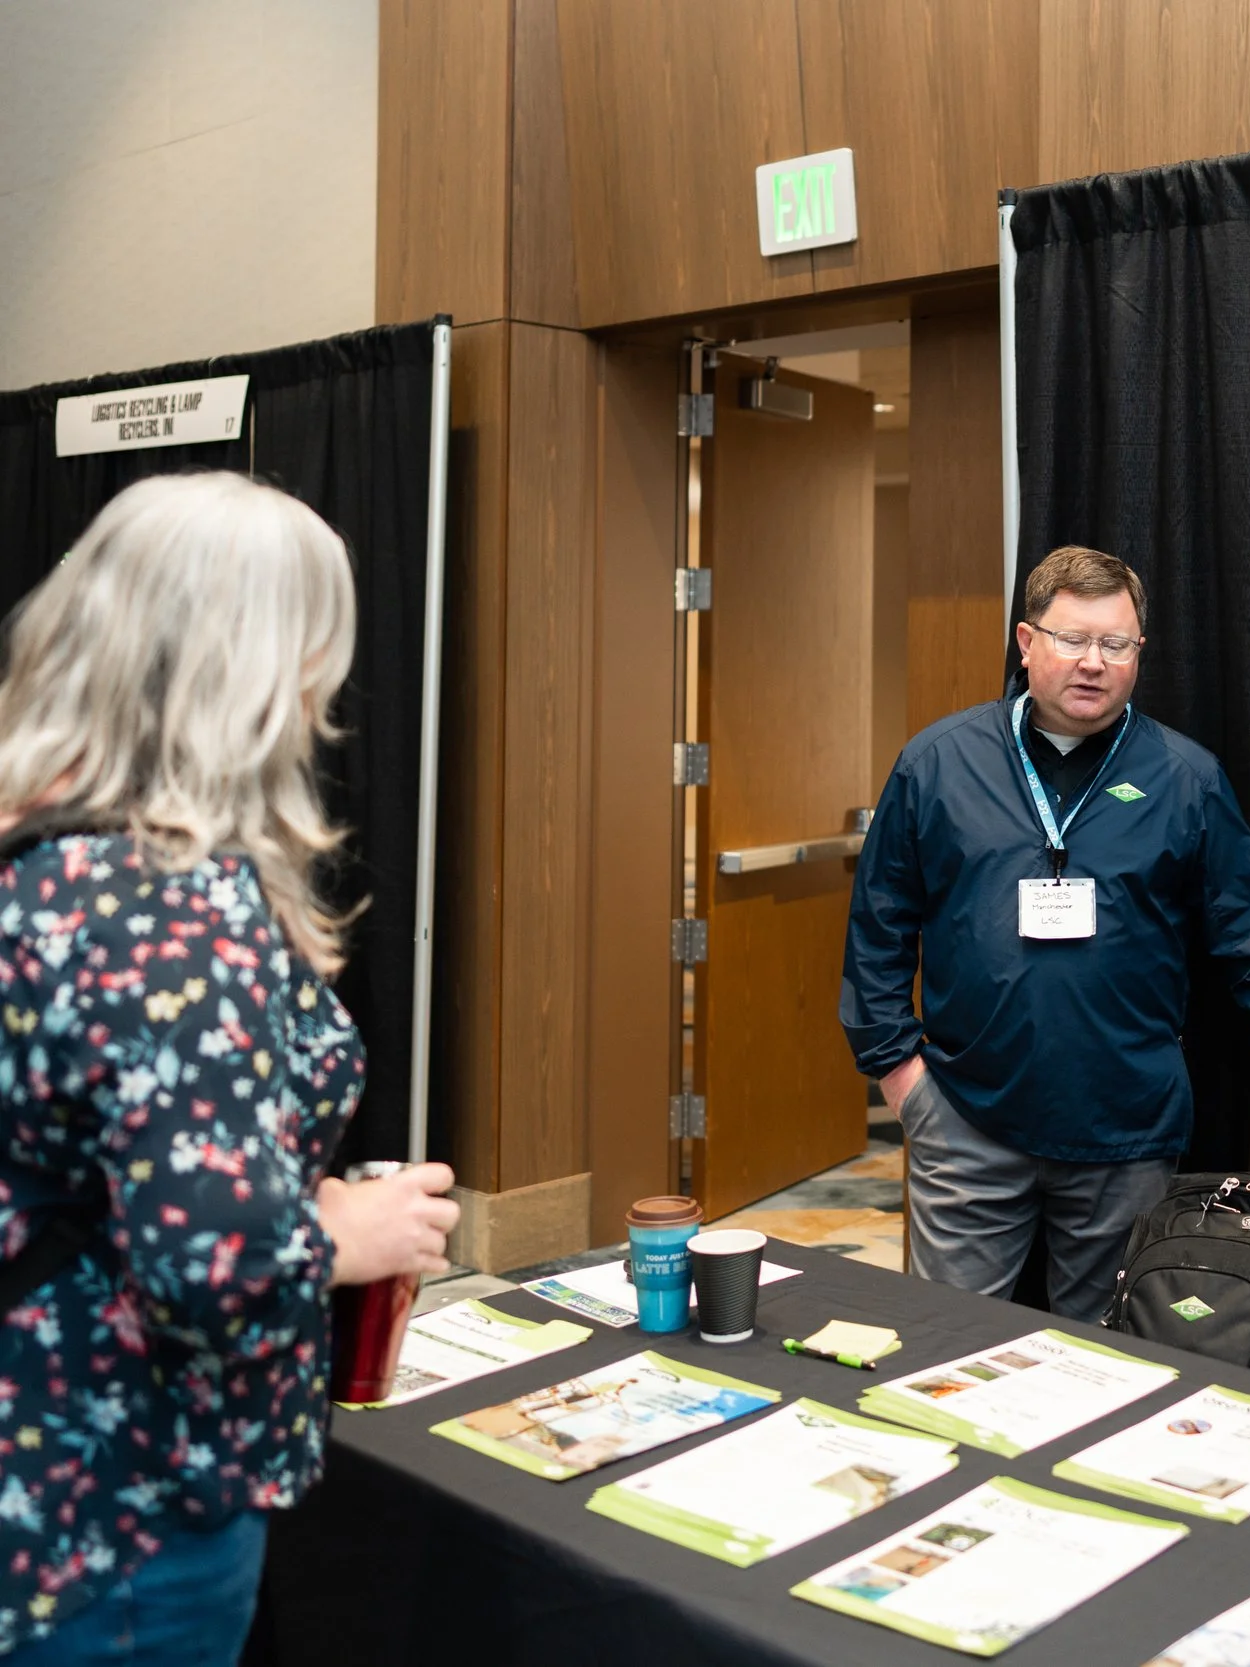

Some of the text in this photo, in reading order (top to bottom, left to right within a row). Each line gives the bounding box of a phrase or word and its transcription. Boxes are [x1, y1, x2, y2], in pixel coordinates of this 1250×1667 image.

[773, 163, 836, 243] EXIT
[91, 401, 127, 423] LOGISTICS
[128, 394, 169, 418] RECYCLING
[178, 392, 203, 412] LAMP
[1033, 891, 1072, 901] JAMES
[669, 1252, 684, 1260] JUST
[635, 1261, 670, 1275] LATTE
[1179, 1304, 1205, 1317] LSC
